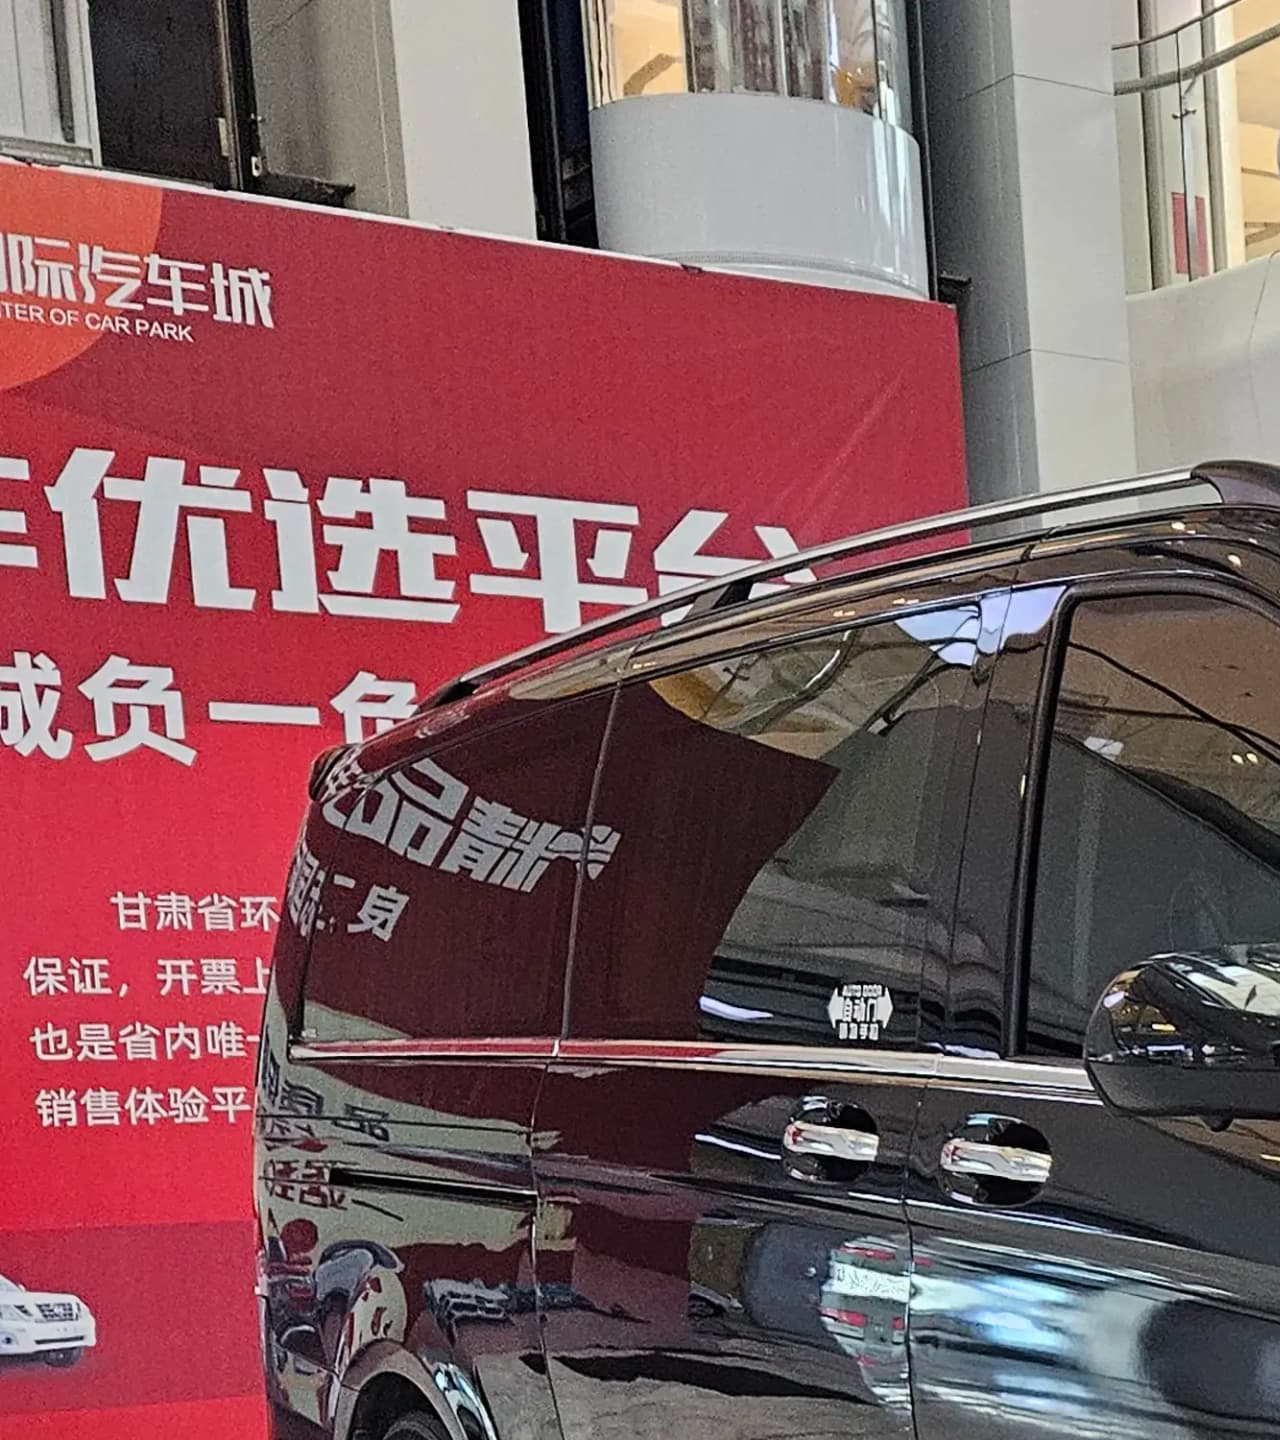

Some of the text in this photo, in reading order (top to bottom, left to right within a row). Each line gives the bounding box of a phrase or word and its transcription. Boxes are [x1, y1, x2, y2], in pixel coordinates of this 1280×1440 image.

[0, 232, 275, 329] 际汽车城
[0, 301, 195, 343] TER OF CAR PARK
[0, 446, 819, 636] 优选平台
[110, 891, 281, 932] 甘肃省环
[34, 1086, 251, 1127] 销售体验平
